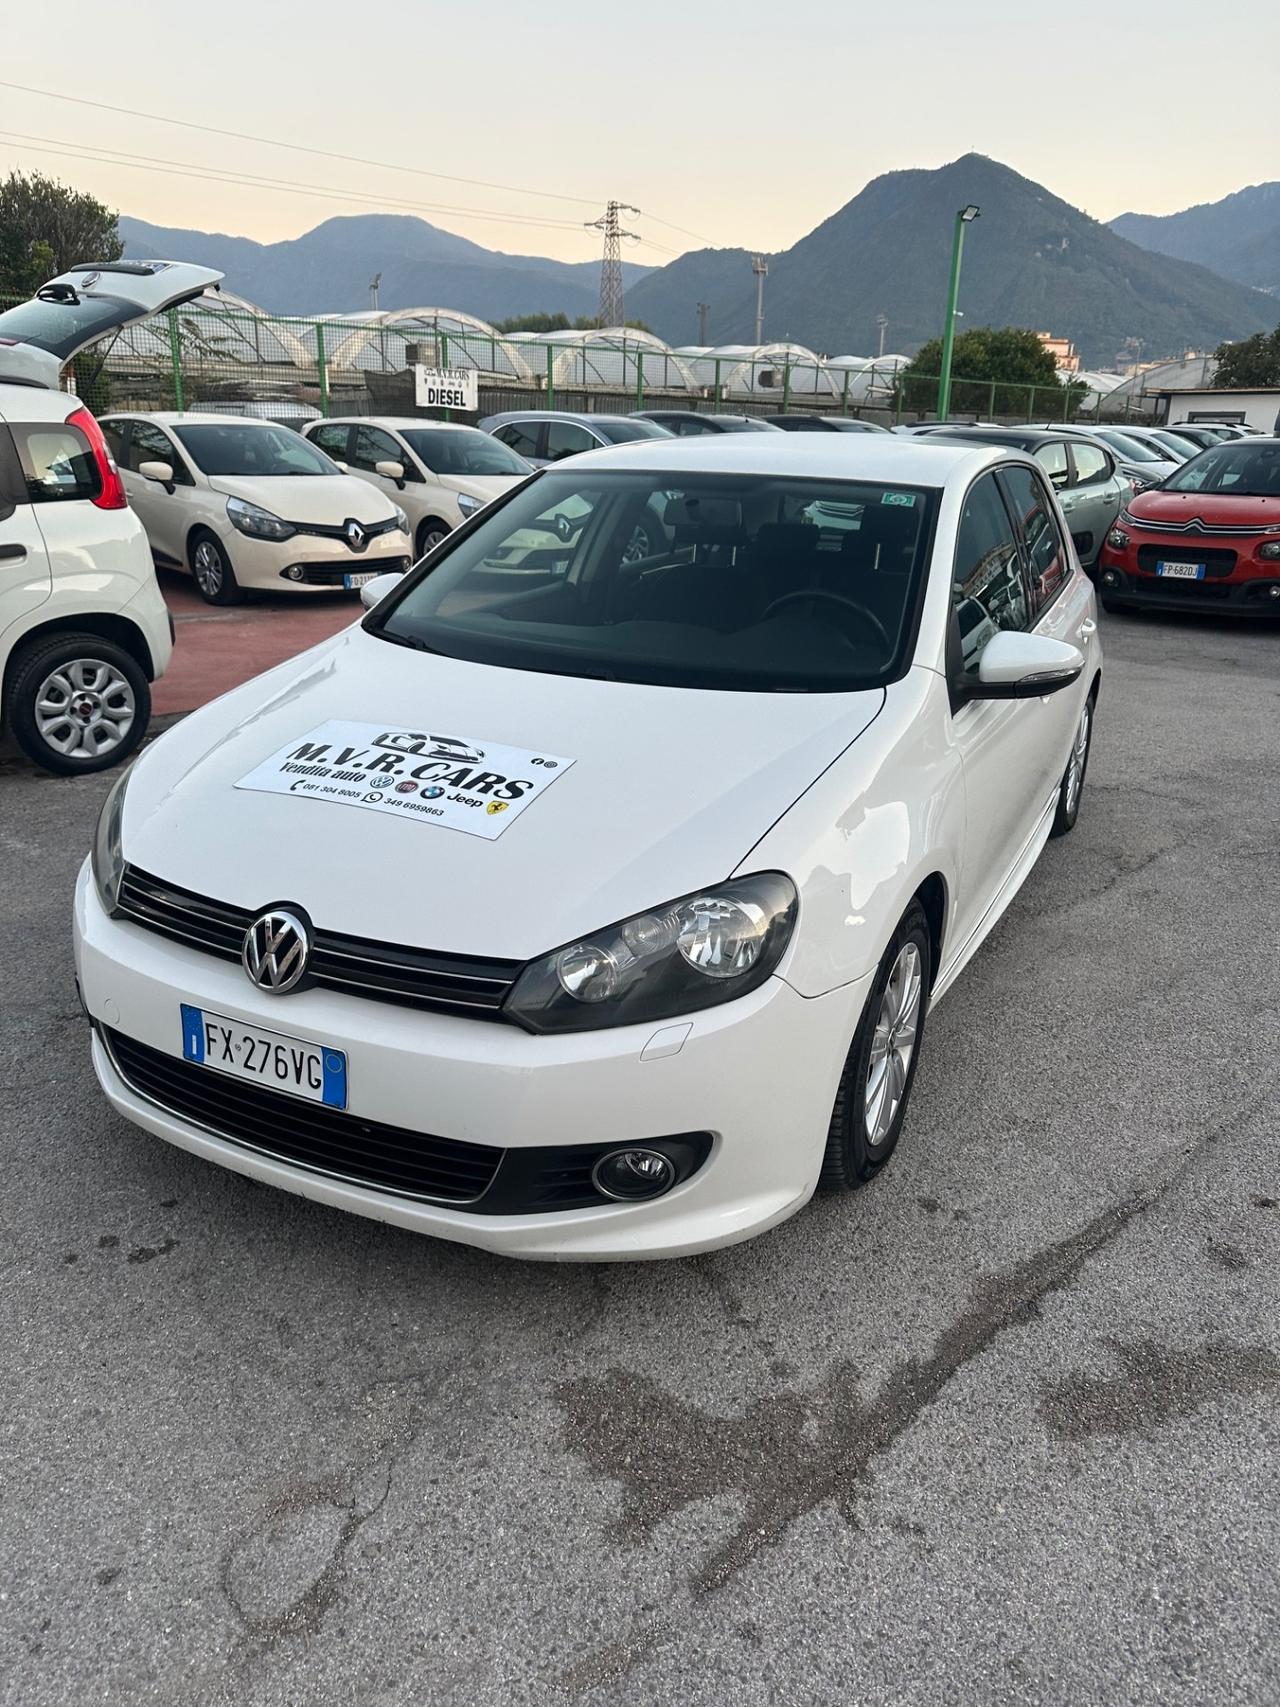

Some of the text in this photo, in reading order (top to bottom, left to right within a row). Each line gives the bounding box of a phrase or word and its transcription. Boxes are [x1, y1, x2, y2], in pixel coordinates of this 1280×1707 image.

[428, 388, 466, 407] DIESEL
[279, 762, 367, 783] Vendita auto
[286, 742, 534, 800] M.V.R. CARS
[383, 797, 445, 817] 349 6959863
[446, 793, 484, 808] Jeep
[205, 1022, 322, 1090] FX 276VG
